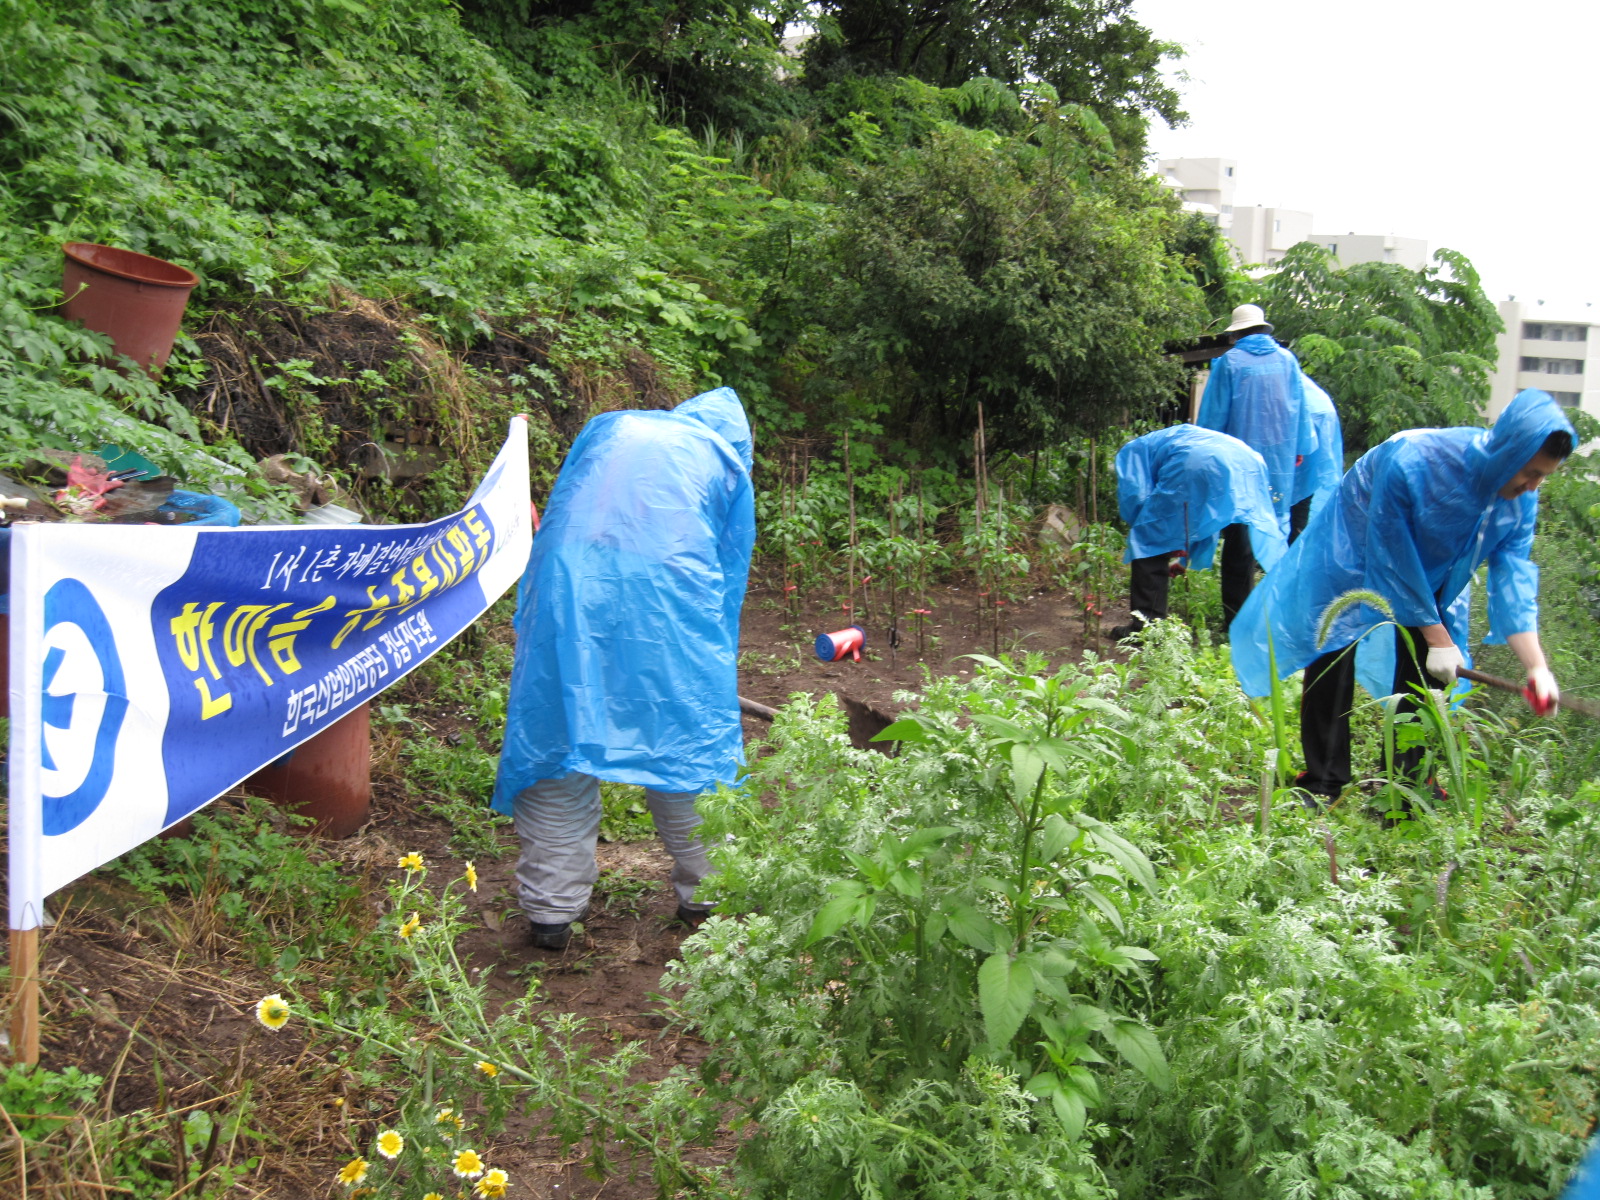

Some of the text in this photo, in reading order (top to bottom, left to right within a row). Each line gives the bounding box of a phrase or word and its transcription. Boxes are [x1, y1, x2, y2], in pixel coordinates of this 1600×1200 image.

[260, 545, 306, 591] 1사
[299, 544, 342, 583] 1촌
[170, 595, 337, 721] 한마음
[282, 609, 438, 738] 한국산업안전공단 경남지도원
